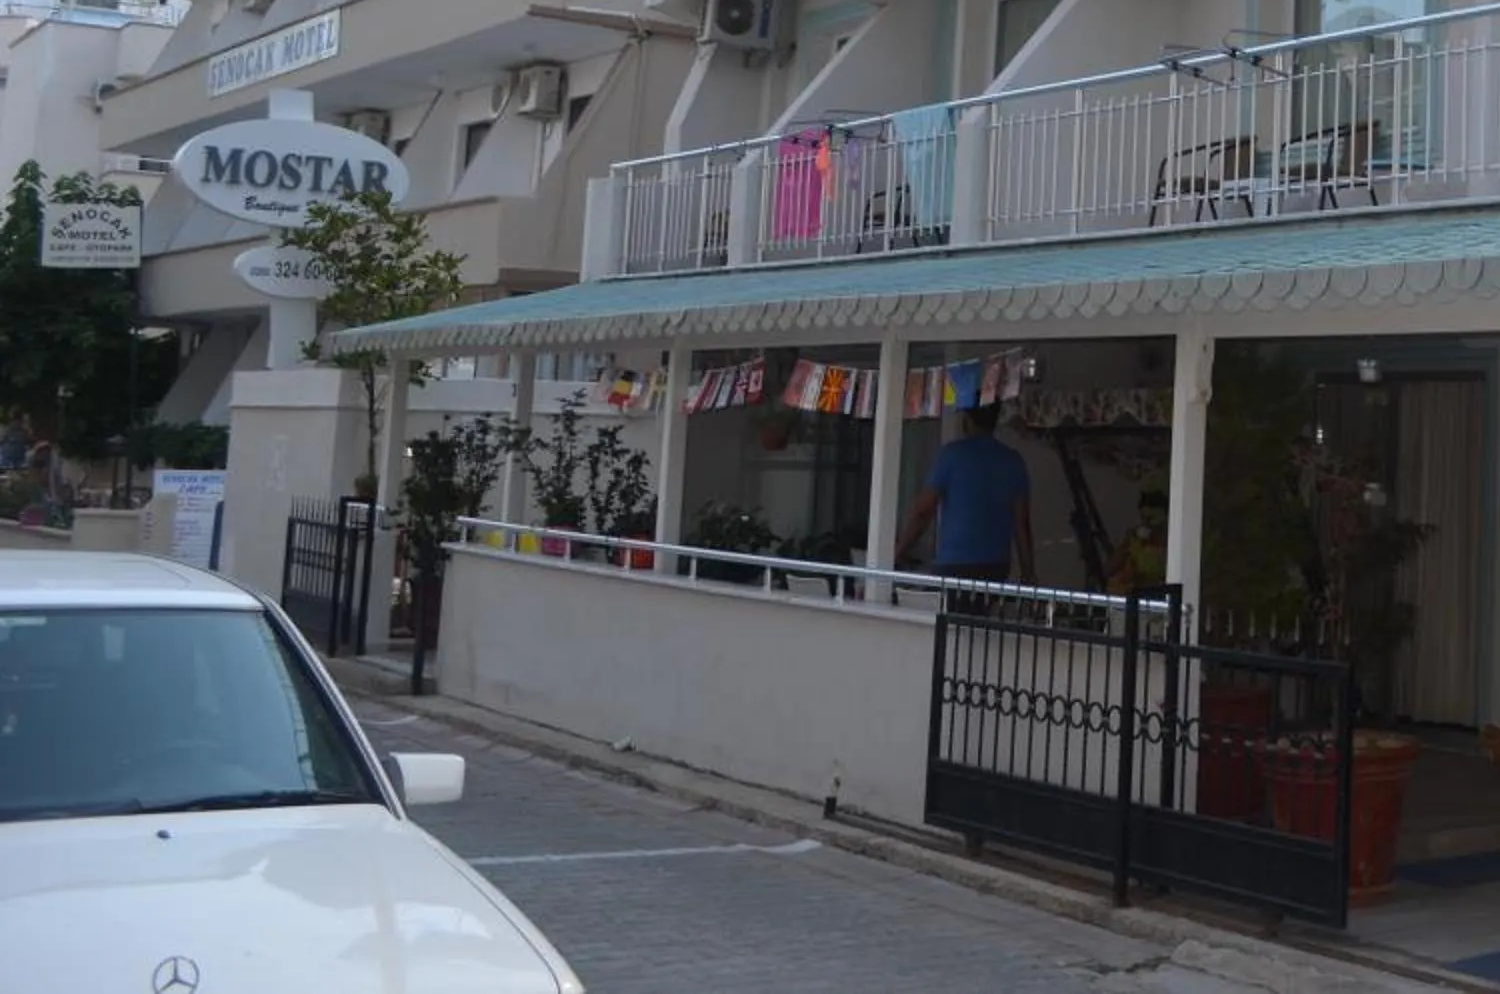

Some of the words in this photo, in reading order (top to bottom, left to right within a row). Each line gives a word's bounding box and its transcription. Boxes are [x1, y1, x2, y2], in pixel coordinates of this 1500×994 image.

[283, 19, 337, 64] MOTEL
[201, 145, 389, 197] MOSTAR
[67, 230, 118, 241] MOTEL
